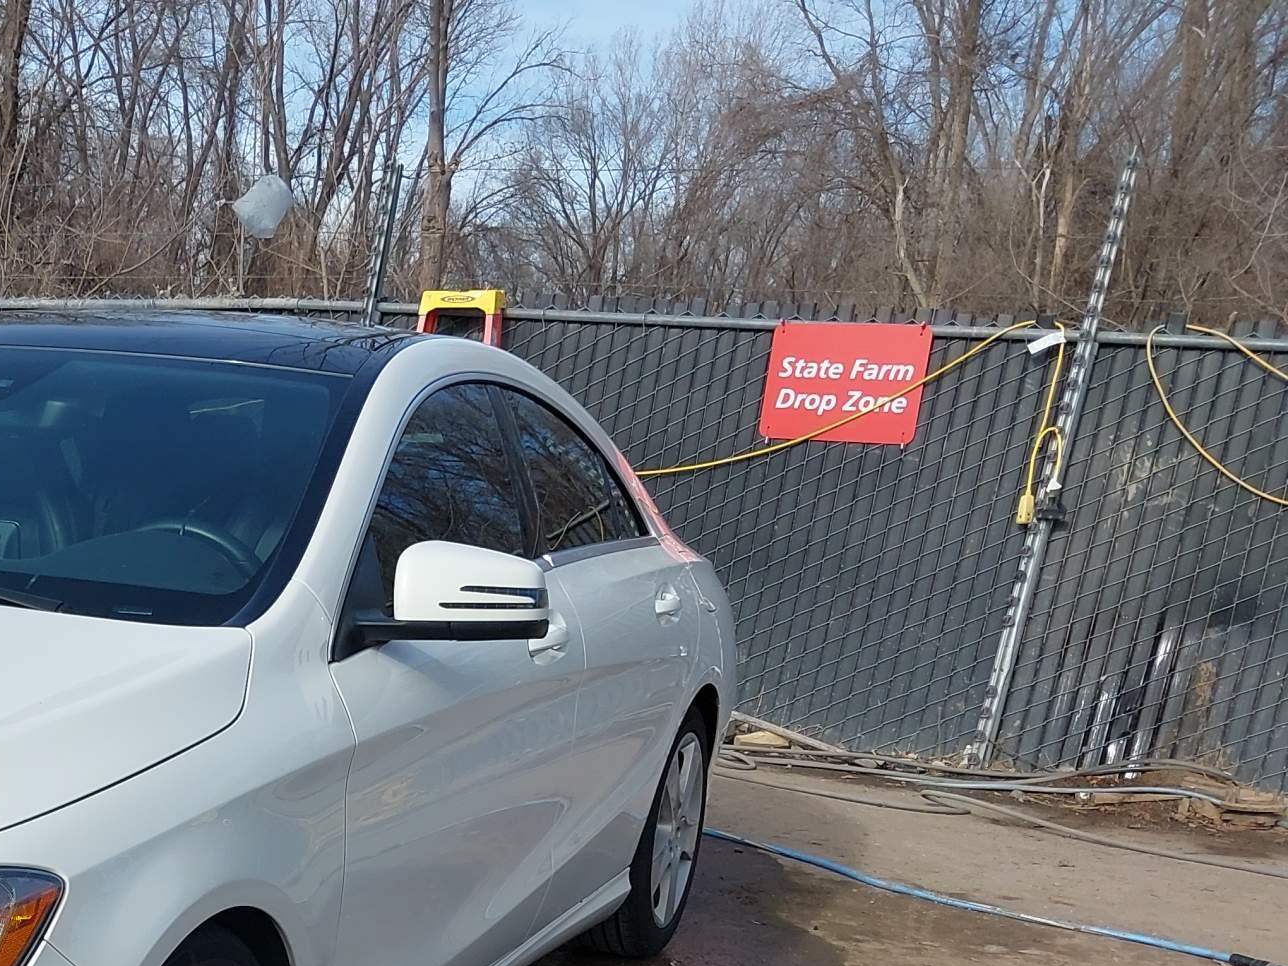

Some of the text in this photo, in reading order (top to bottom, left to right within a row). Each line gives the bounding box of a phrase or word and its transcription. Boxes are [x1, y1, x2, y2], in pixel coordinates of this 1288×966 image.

[778, 356, 915, 382] State Farm
[775, 388, 908, 416] Drop Zone
